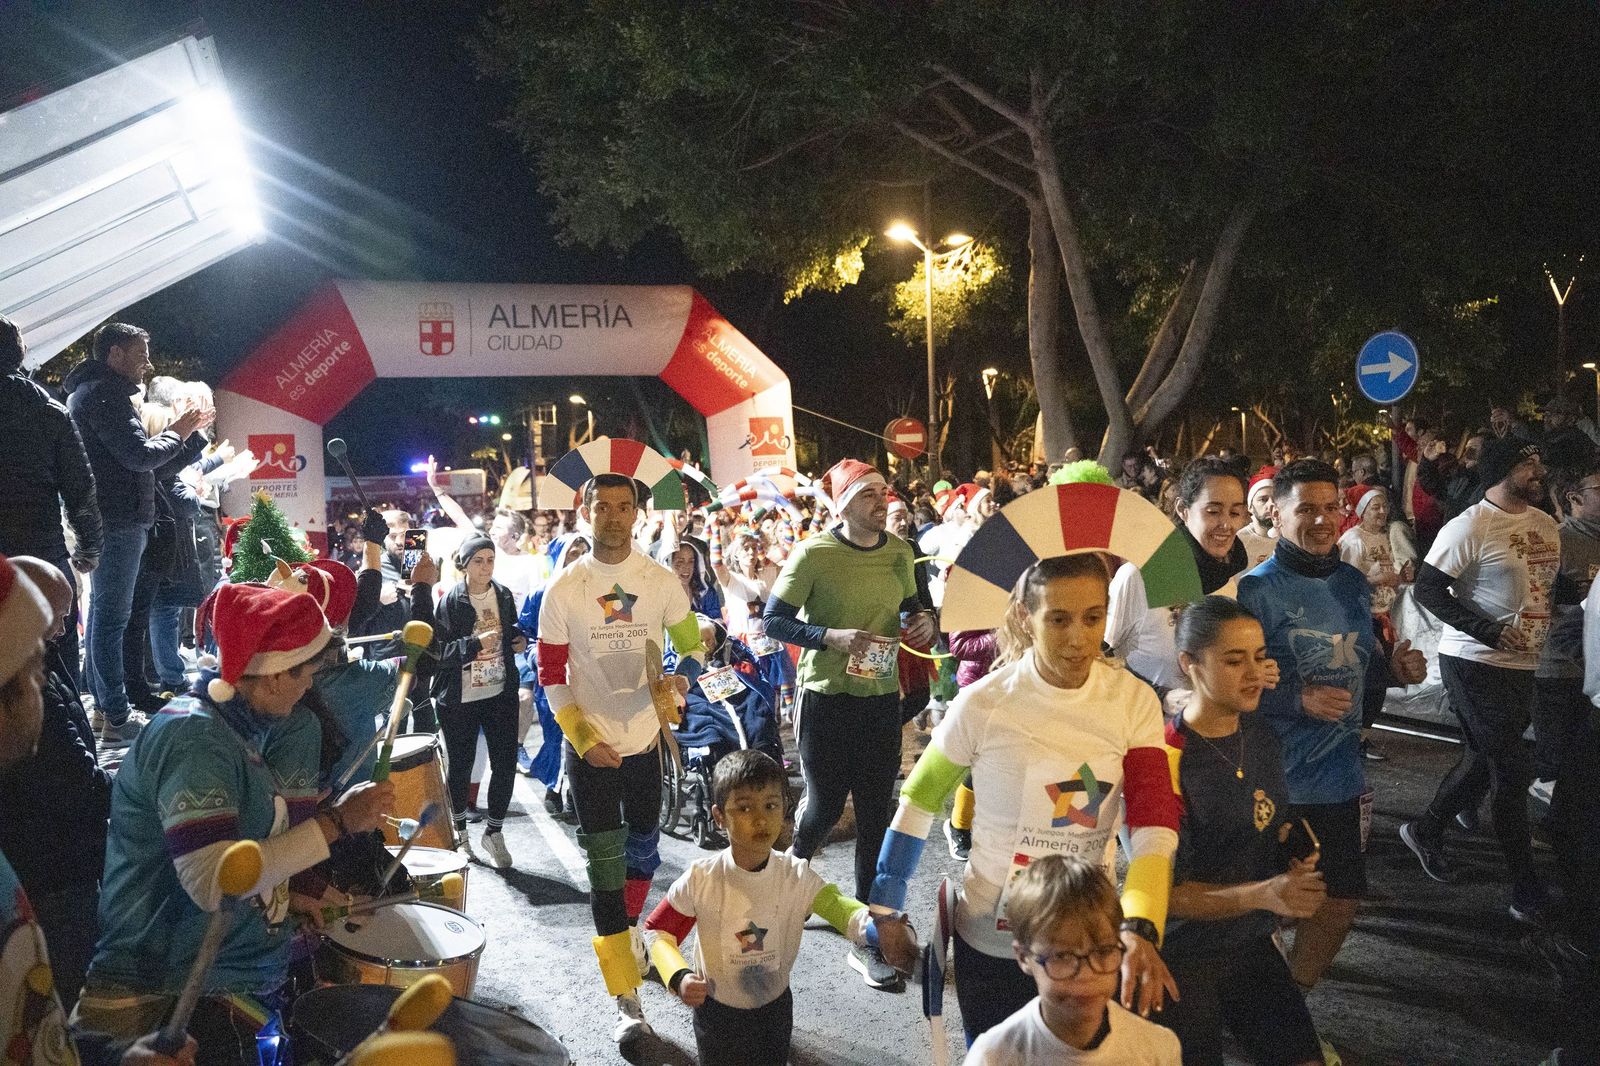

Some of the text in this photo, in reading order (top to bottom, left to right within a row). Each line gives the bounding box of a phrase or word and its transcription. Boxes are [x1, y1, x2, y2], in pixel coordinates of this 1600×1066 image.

[488, 300, 633, 329] ALMERÍA
[487, 335, 563, 351] CIUDAD
[289, 341, 352, 400] es deporte
[692, 340, 748, 389] es deporte
[250, 484, 298, 493] DEPORTES
[591, 629, 648, 640] Almería 2005
[1037, 828, 1064, 838] Juegos
[1020, 835, 1079, 853] Almería
